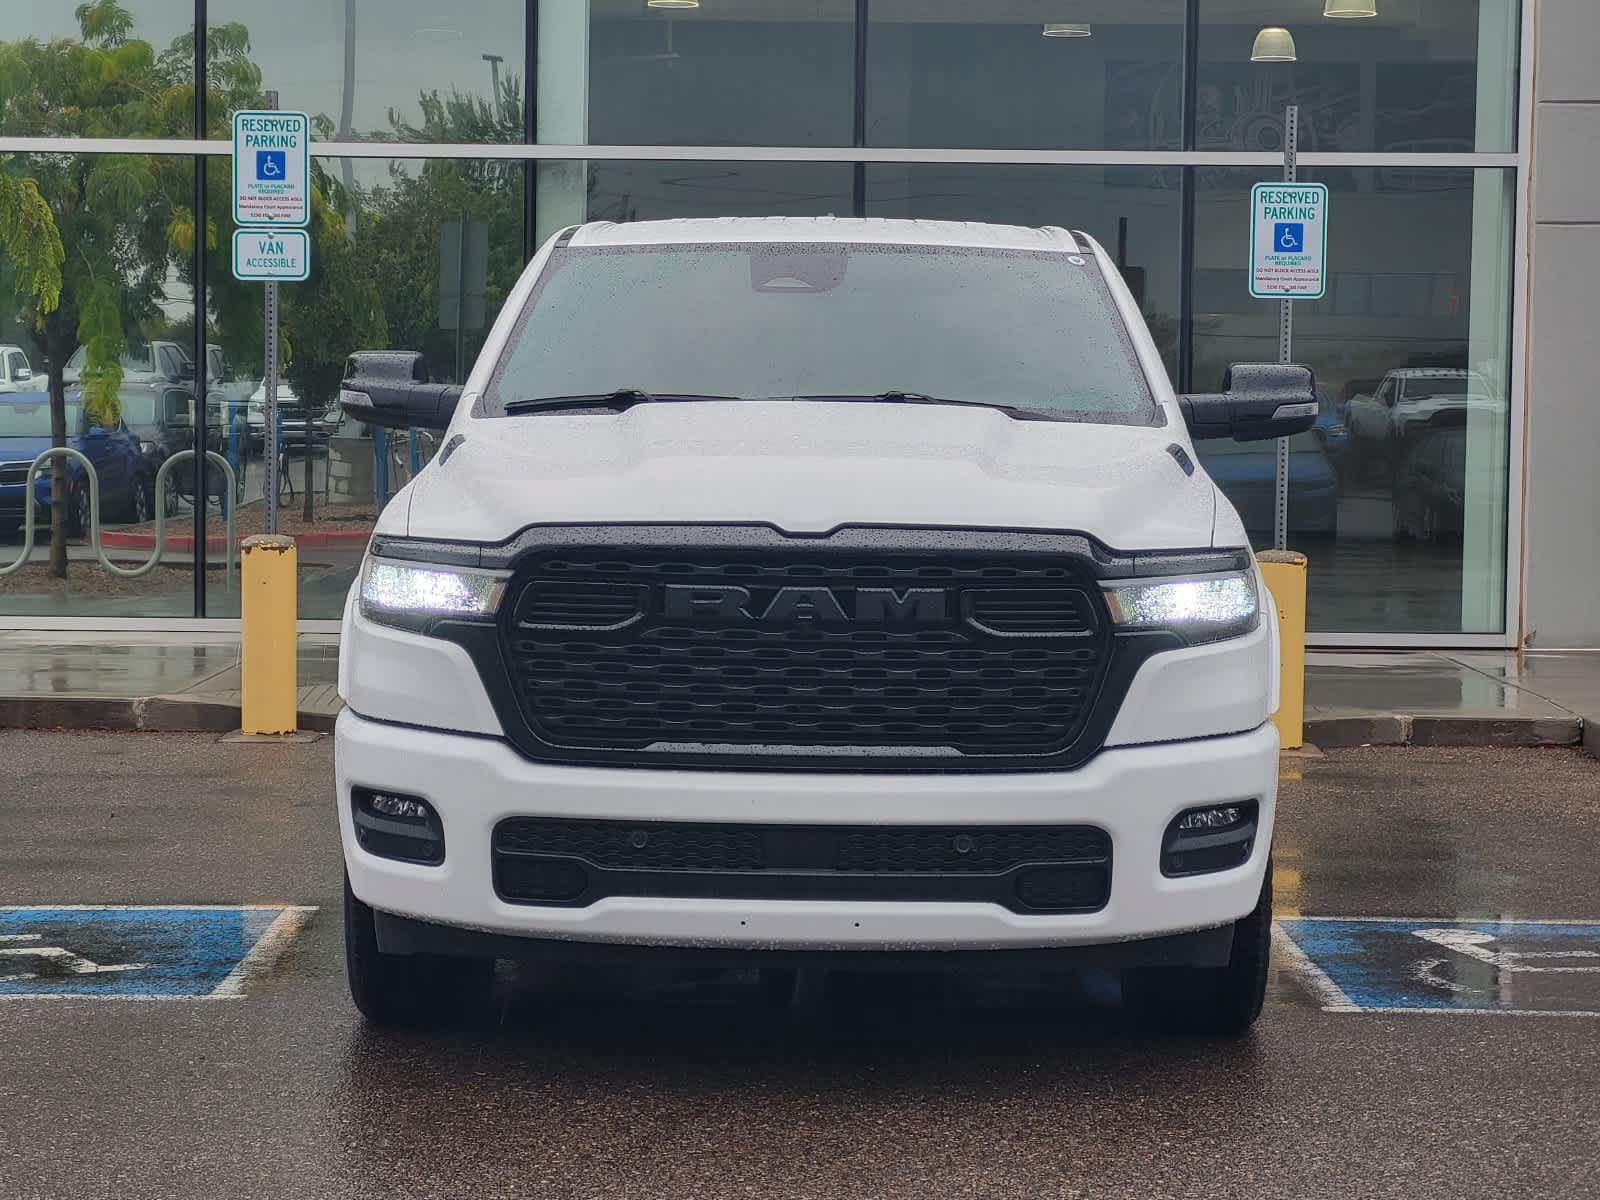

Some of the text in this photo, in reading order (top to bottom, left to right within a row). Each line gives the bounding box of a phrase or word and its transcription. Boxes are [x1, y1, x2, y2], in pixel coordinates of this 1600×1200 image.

[241, 119, 301, 132] RESERVED
[246, 135, 297, 148] PARKING
[1260, 191, 1319, 204] RESERVED
[1264, 207, 1315, 220] PARKING
[259, 241, 283, 255] VAN
[247, 258, 296, 268] ACCESSIBLE
[663, 583, 948, 624] RAM
